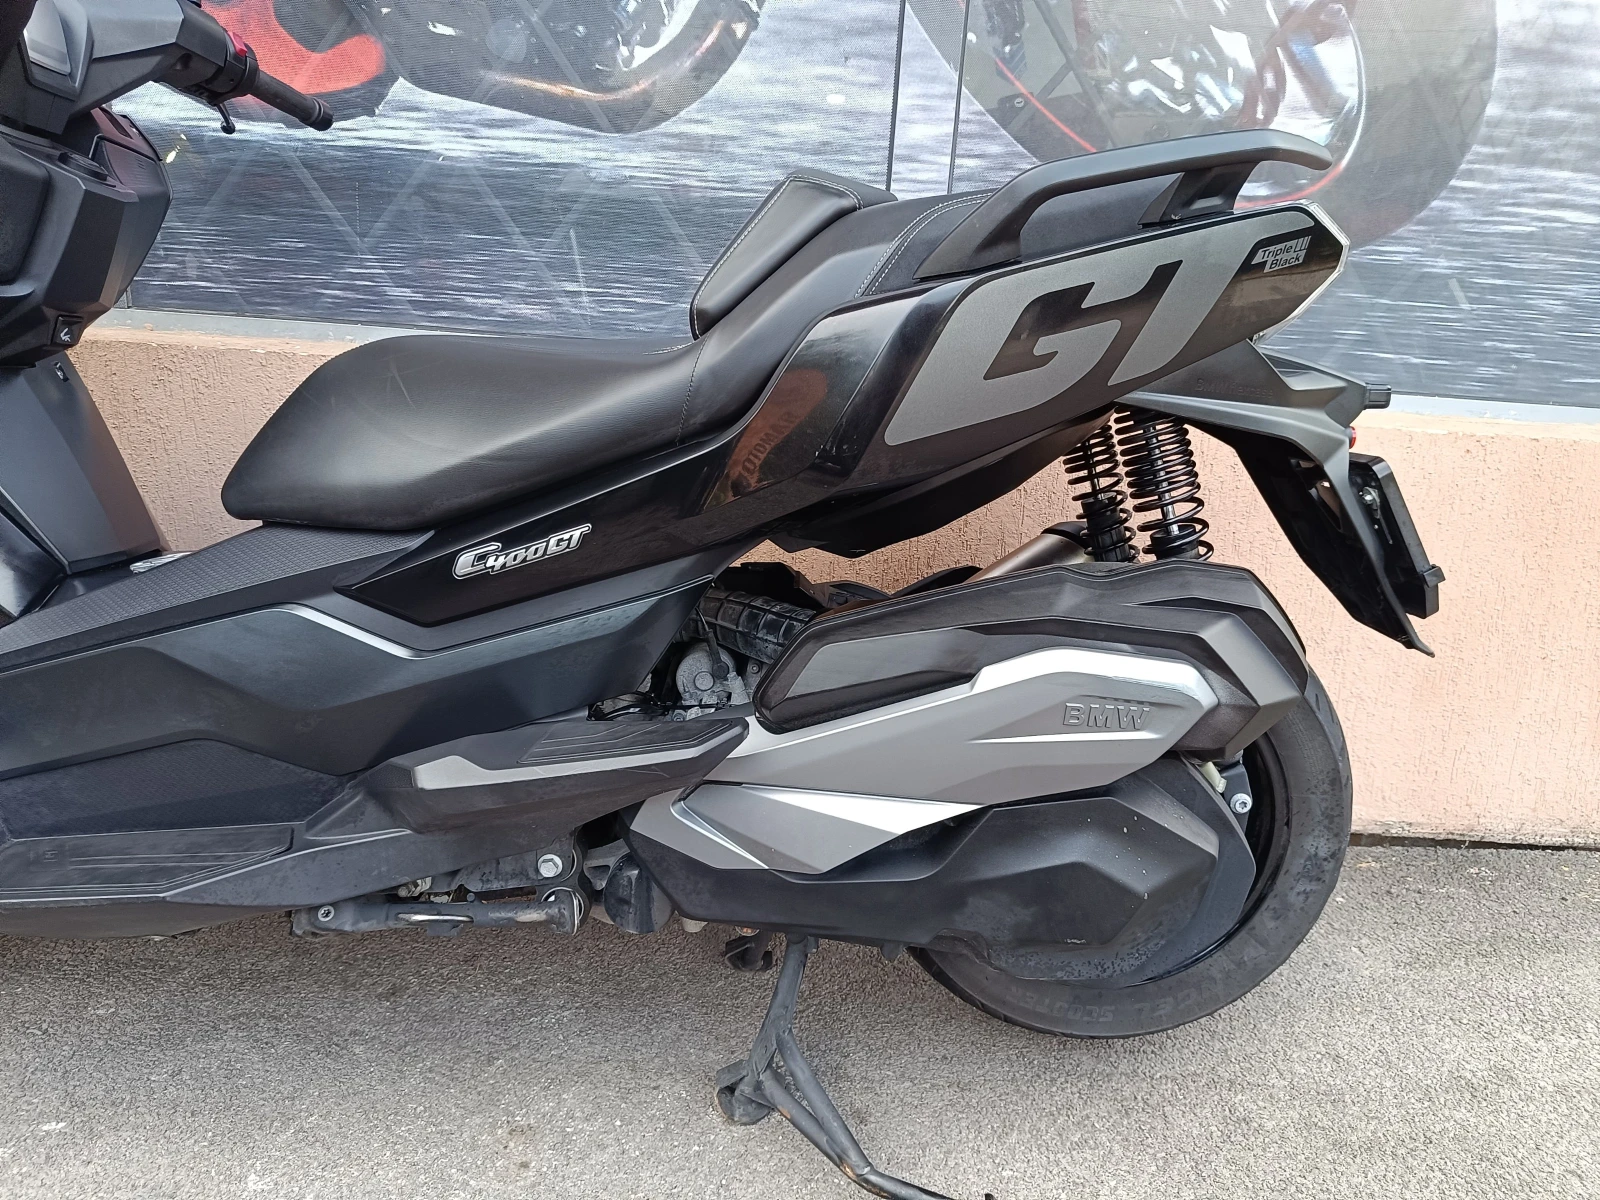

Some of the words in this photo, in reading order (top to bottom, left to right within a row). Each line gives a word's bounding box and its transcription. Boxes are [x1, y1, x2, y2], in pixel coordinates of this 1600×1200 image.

[1260, 243, 1294, 261] Triple
[1269, 254, 1302, 270] Black
[884, 210, 1316, 446] GT
[1062, 702, 1150, 730] BMW
